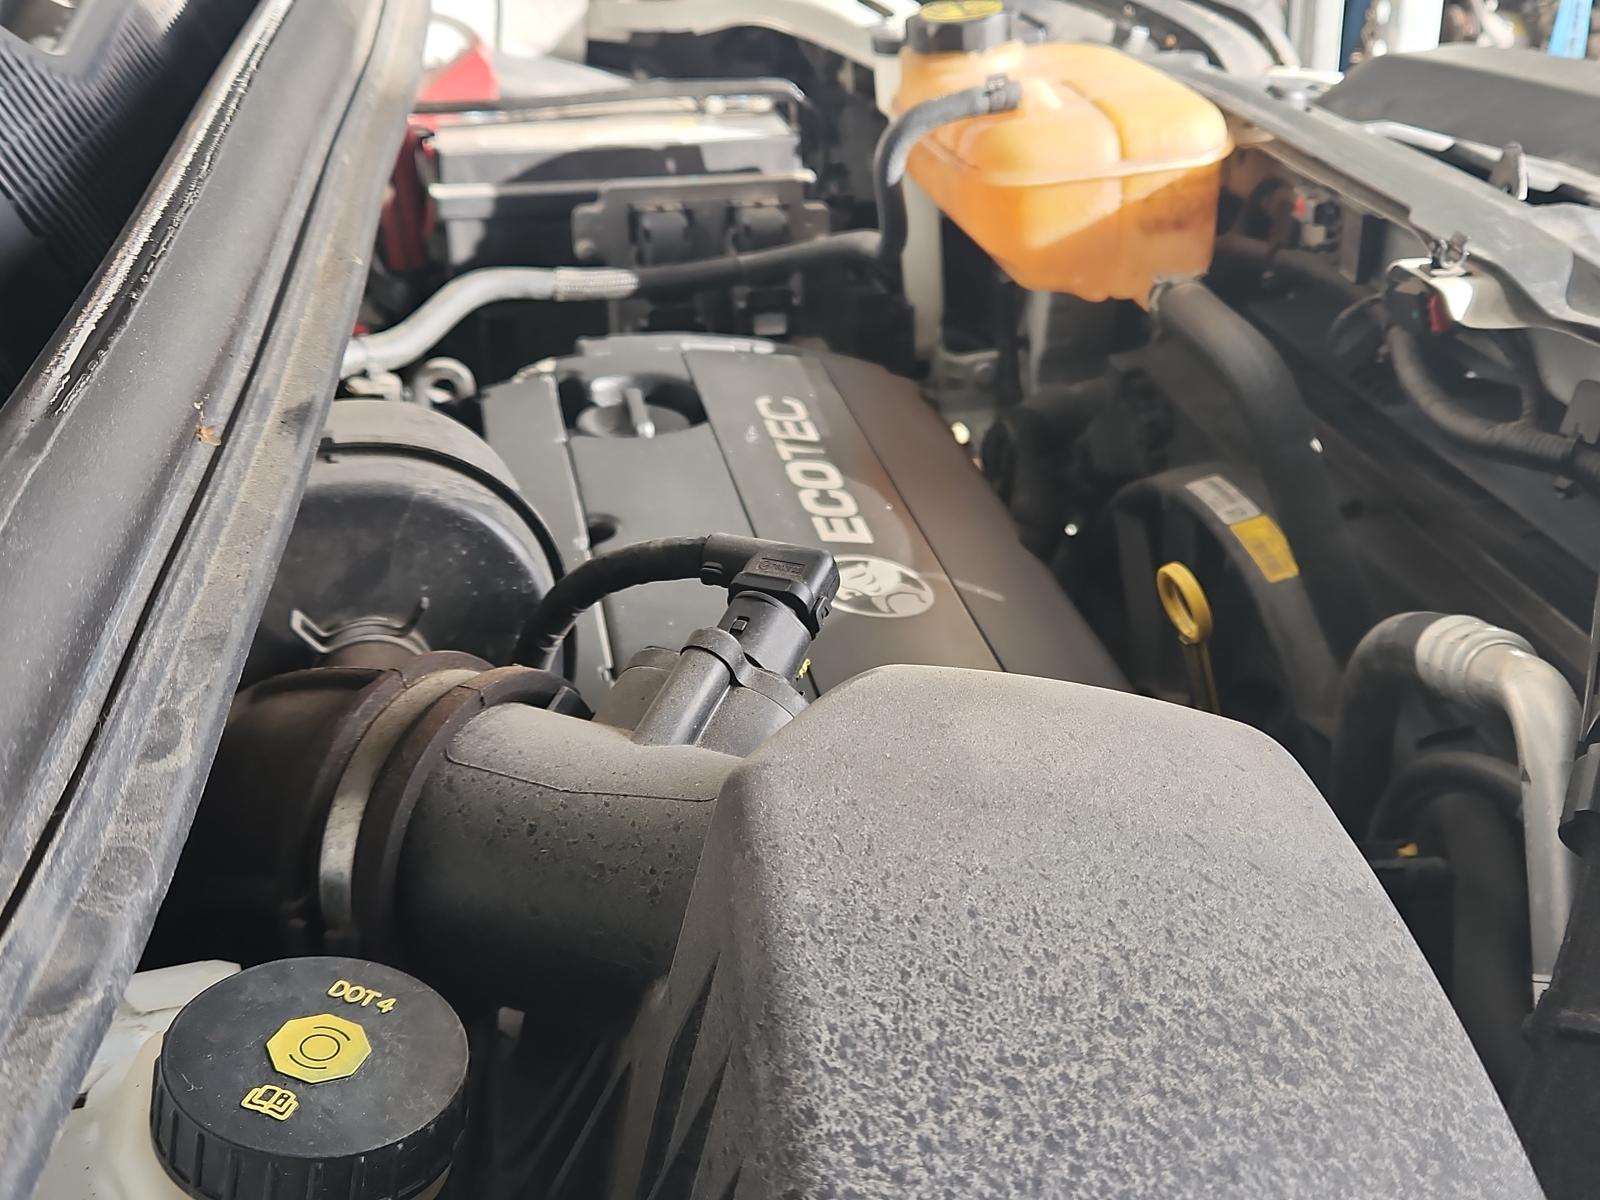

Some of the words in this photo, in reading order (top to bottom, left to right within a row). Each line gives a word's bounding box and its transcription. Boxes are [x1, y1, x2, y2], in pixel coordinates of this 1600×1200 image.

[756, 395, 874, 544] ECOTEC
[327, 980, 382, 1006] DOT
[376, 998, 397, 1013] 4
